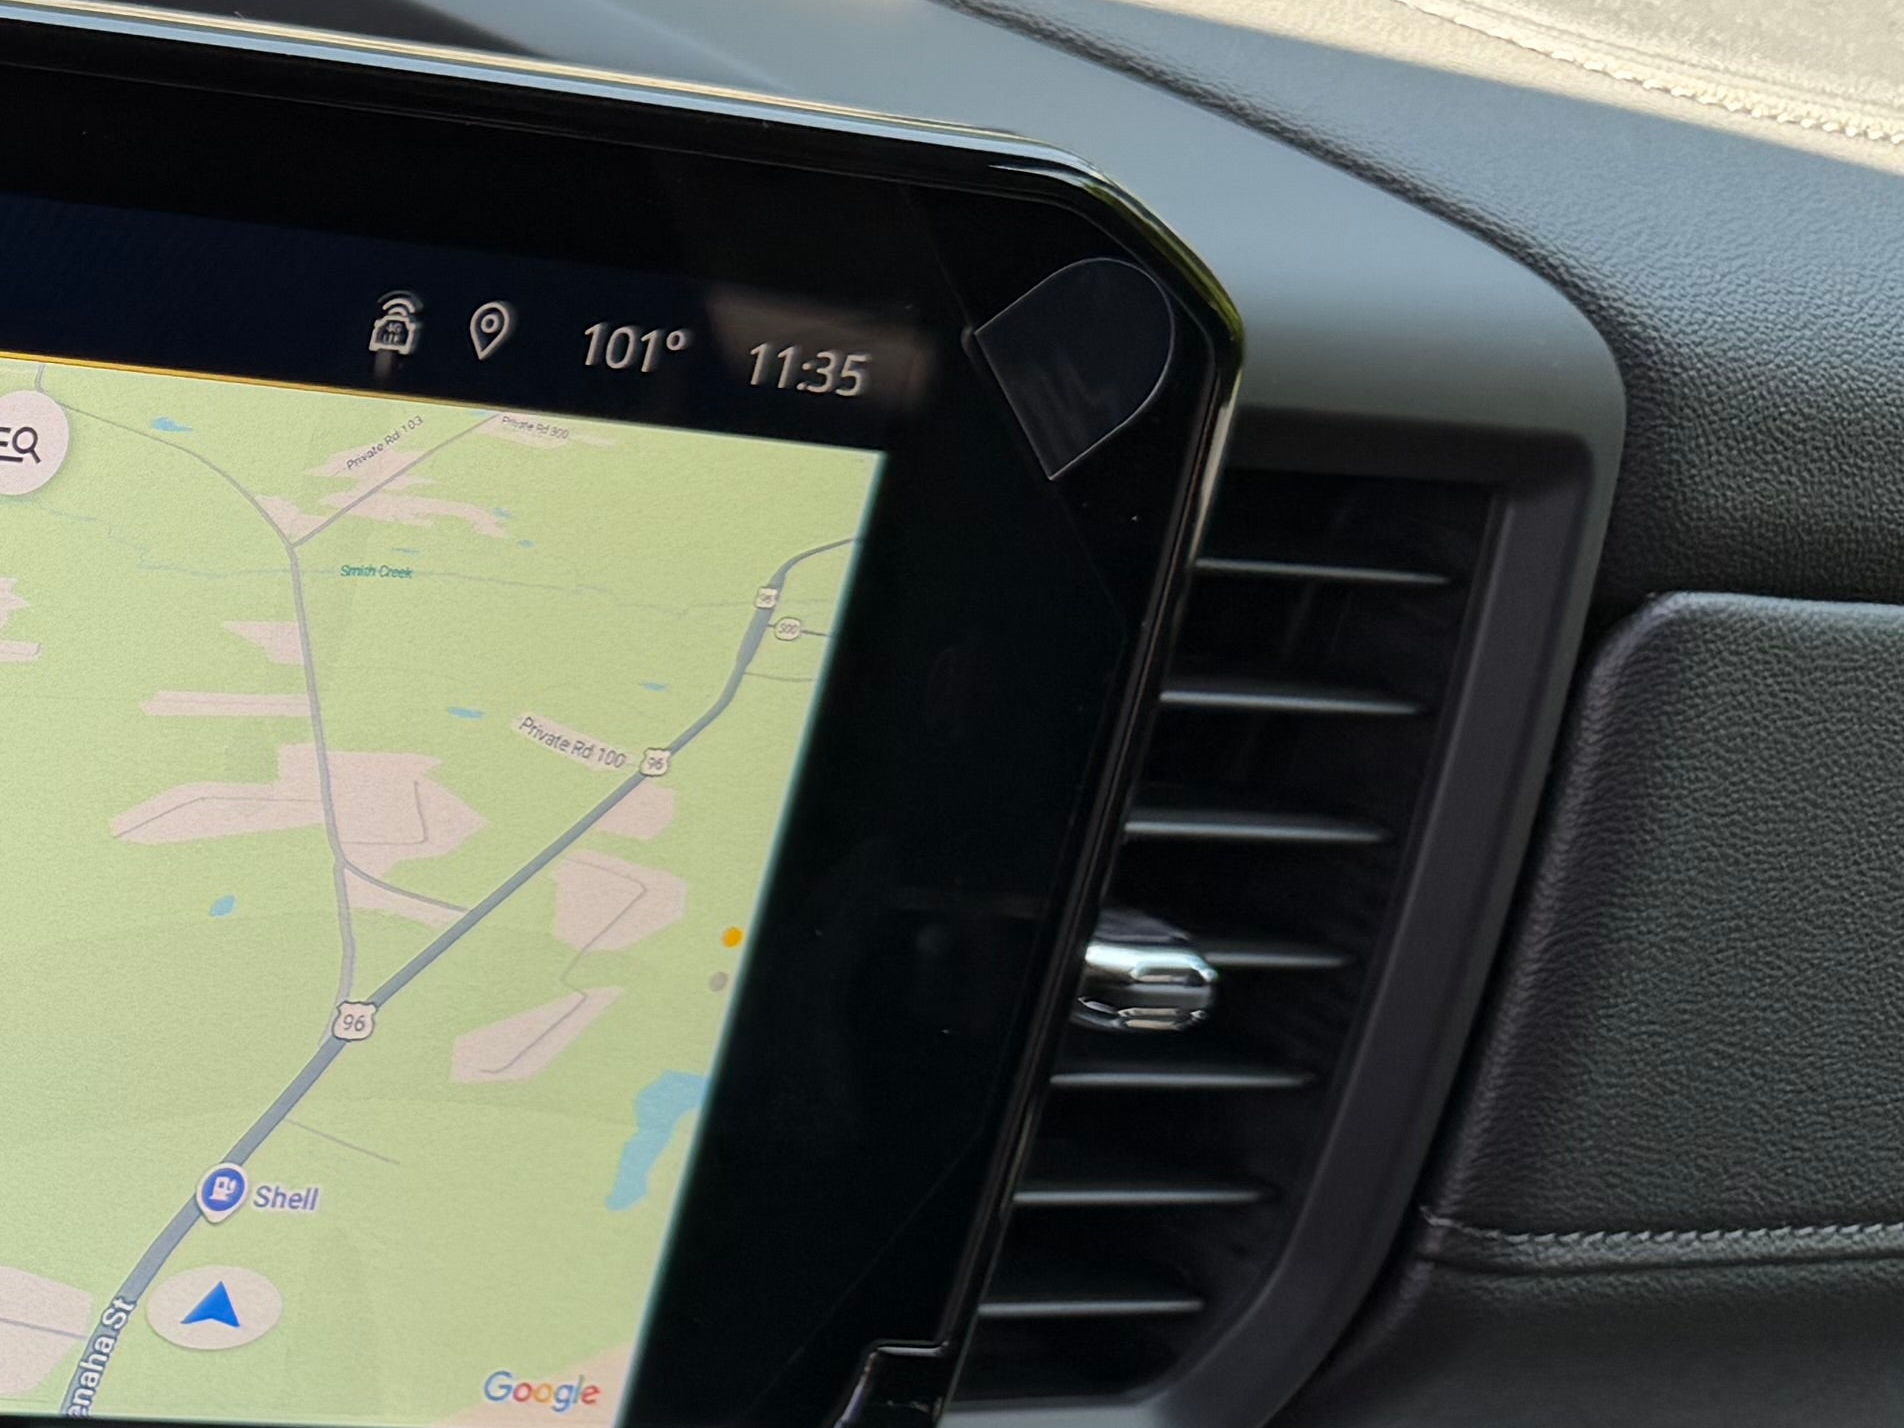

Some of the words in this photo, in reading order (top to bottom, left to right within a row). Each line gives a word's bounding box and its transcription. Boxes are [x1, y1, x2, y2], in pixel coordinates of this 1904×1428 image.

[584, 322, 690, 373] 101°
[750, 343, 870, 397] 11:35
[346, 443, 385, 470] Private
[384, 431, 401, 446] Rd
[402, 415, 424, 434] 103
[378, 565, 414, 579] Creek
[518, 716, 571, 753] Private
[571, 739, 594, 759] Rd
[597, 746, 627, 769] 100
[343, 1014, 365, 1032] 96
[253, 1184, 319, 1211] Shell
[101, 1296, 136, 1330] St
[483, 1370, 602, 1412] Google
